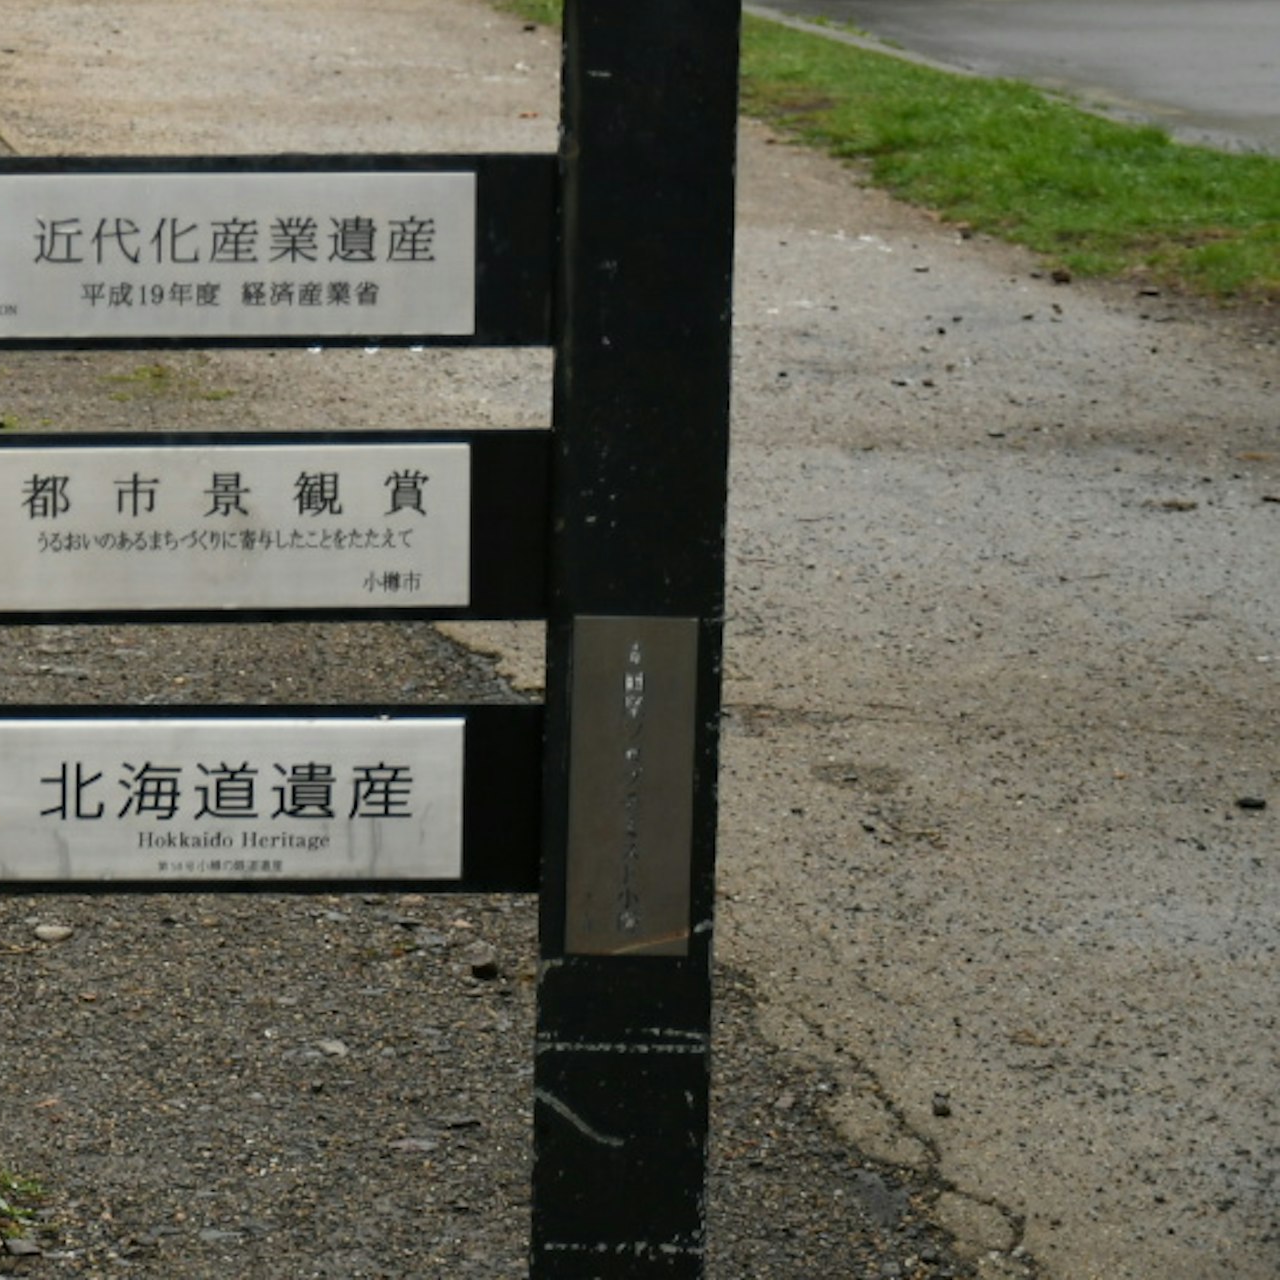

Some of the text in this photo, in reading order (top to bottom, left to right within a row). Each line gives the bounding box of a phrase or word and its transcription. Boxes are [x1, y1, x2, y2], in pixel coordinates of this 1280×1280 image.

[33, 214, 438, 265] 近代化産業遺産
[81, 280, 380, 308] 平成19年度 経済産業省
[21, 468, 431, 521] 都市景観賞
[37, 528, 414, 553] うるおいのあるまちづくりに寄与したことをたたえて
[362, 570, 422, 593] 小樽市
[39, 760, 415, 821] 北海道遺産
[137, 830, 331, 852] Hokkaido Heritage
